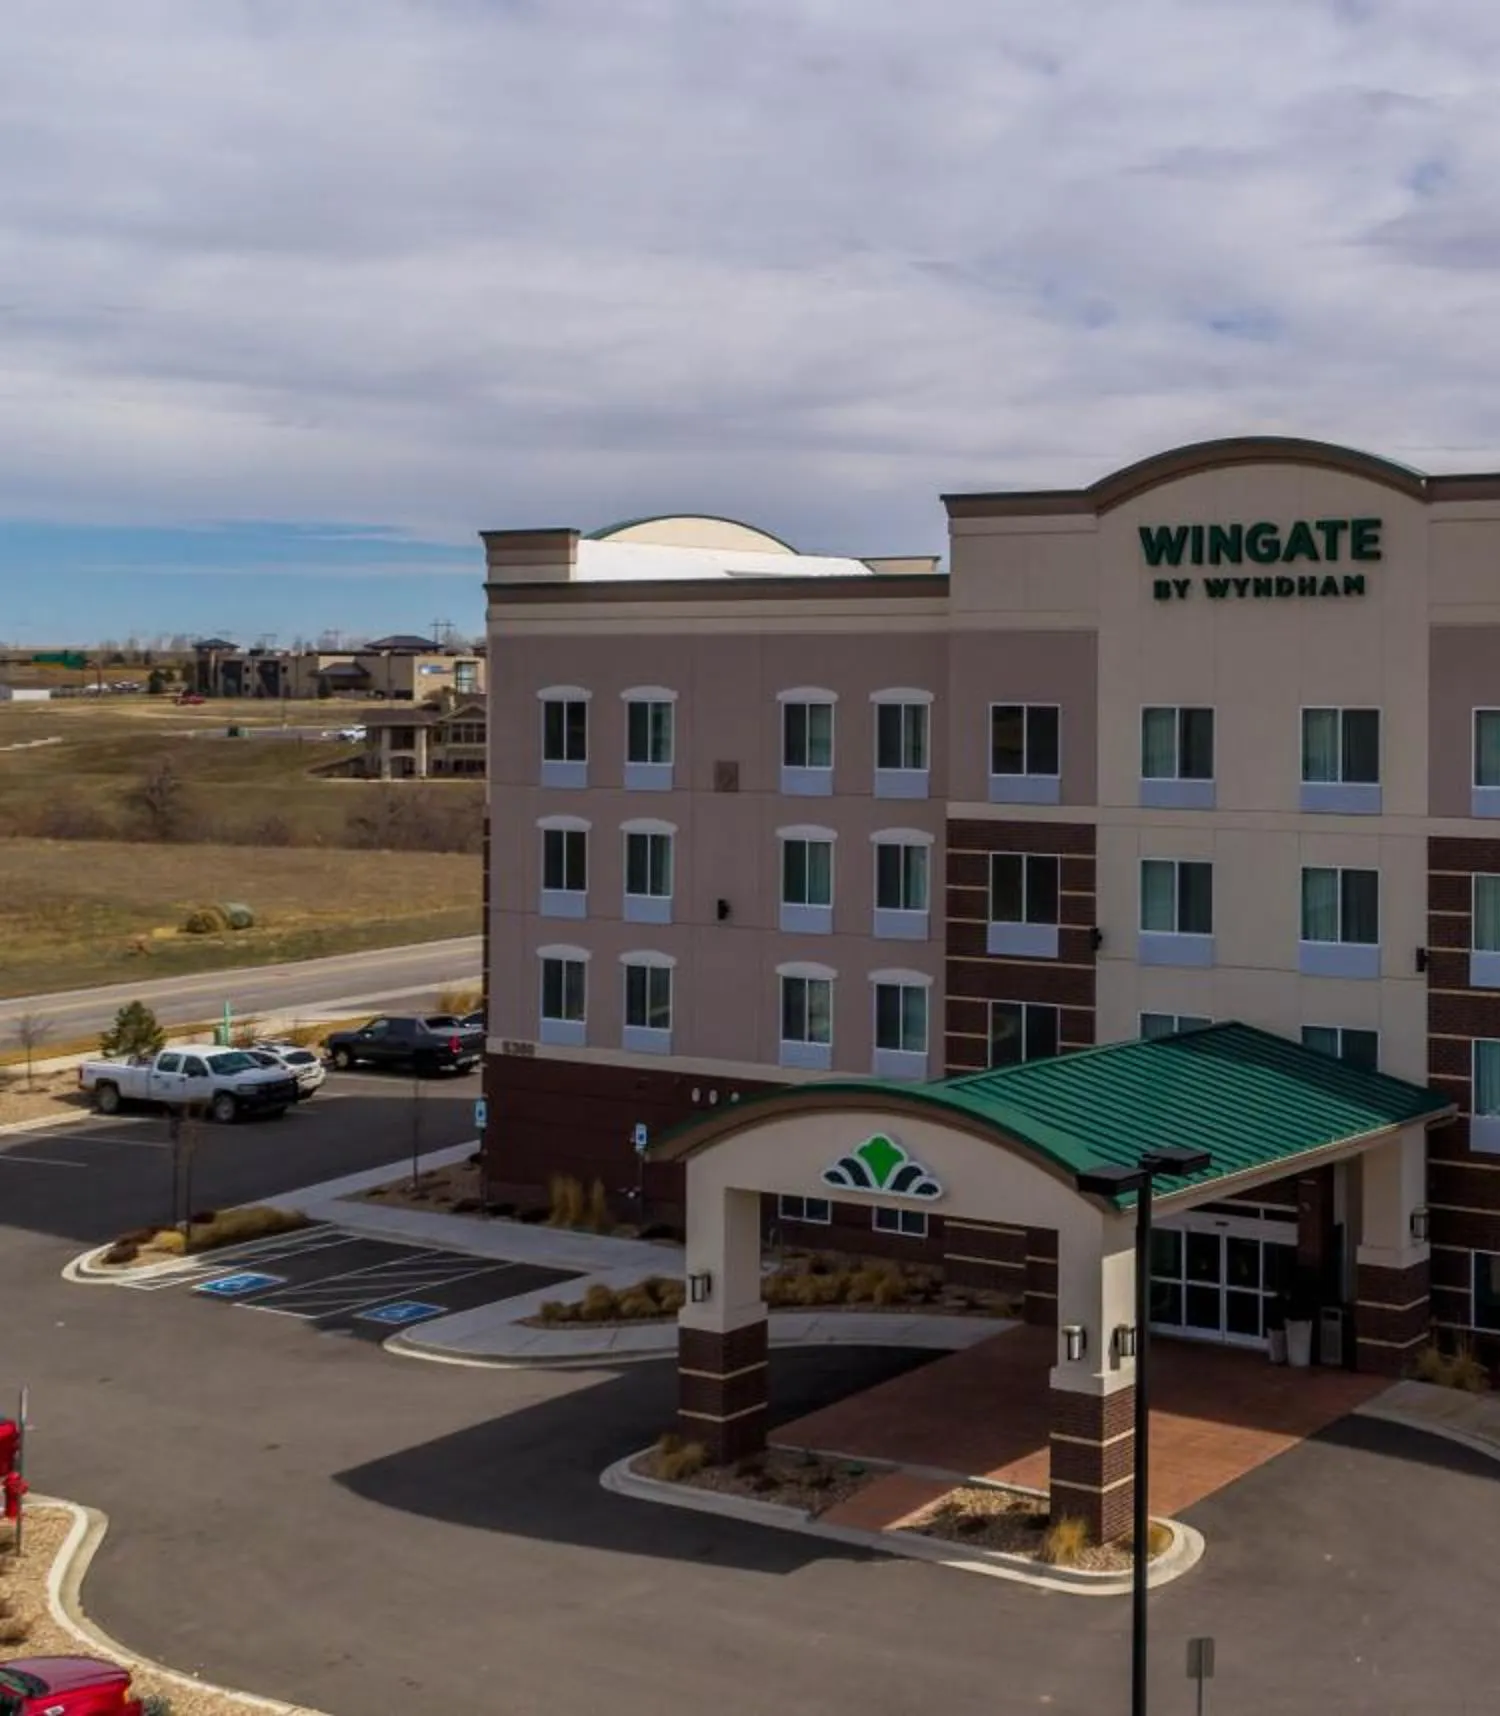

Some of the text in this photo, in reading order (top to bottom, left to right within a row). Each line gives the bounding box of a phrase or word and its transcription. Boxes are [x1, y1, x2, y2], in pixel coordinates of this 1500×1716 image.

[1138, 518, 1383, 567] WINGATE
[1153, 574, 1366, 600] BY WYNDHAM
